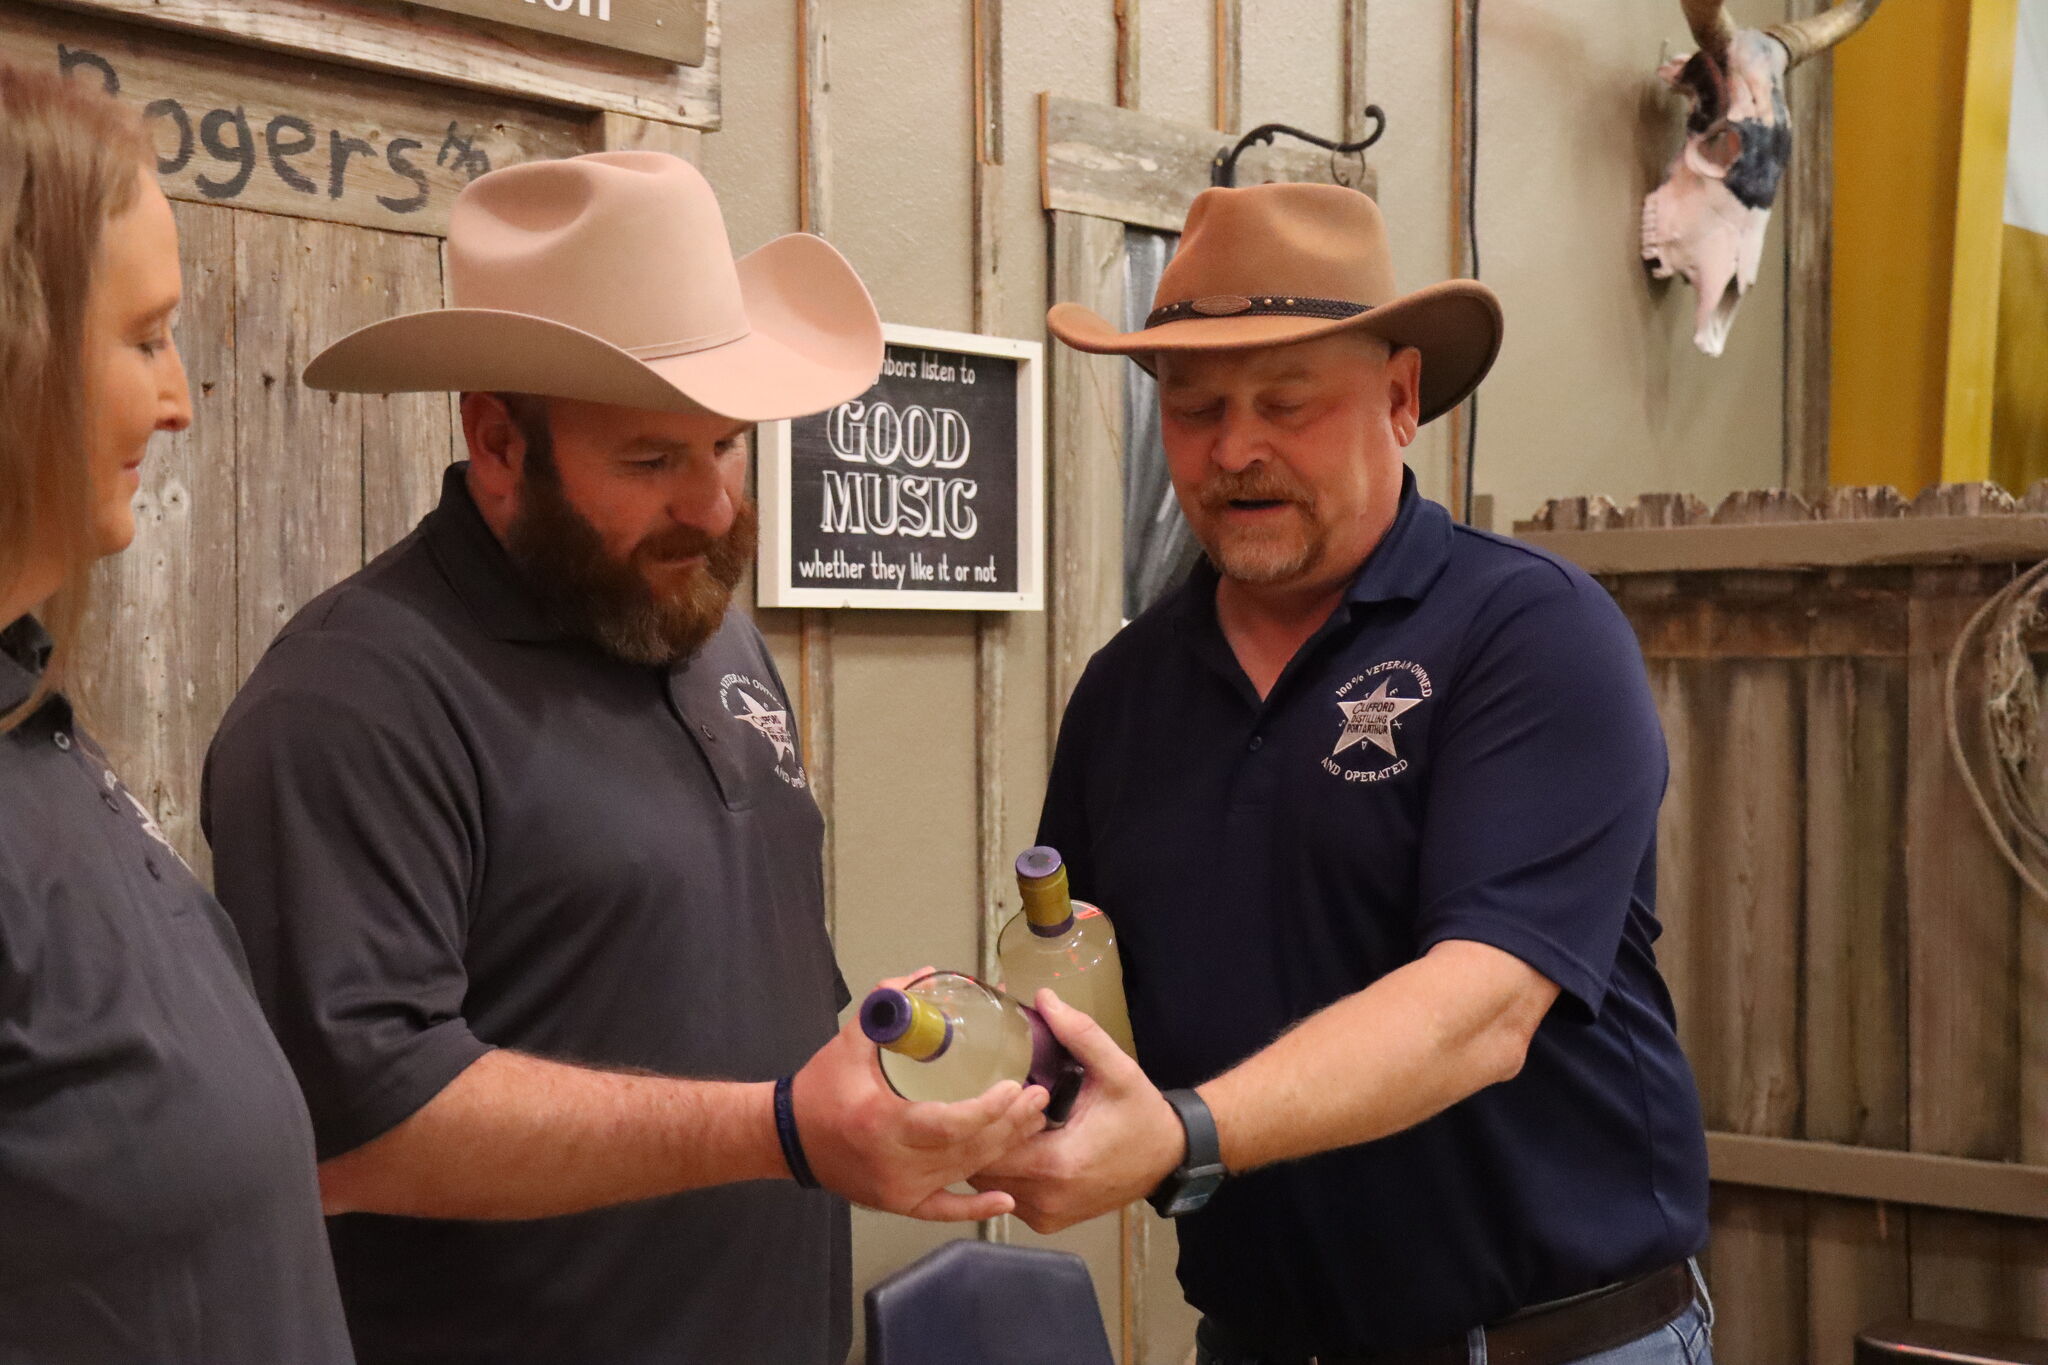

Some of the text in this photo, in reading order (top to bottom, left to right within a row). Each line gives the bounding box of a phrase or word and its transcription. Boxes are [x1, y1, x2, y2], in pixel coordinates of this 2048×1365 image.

[921, 351, 956, 382] listen
[960, 356, 976, 385] to
[826, 399, 971, 469] GOOD
[819, 469, 978, 540] MUSIC
[799, 548, 998, 590] whether they like it or not
[1365, 660, 1412, 676] VETERAN
[1410, 664, 1433, 698] OWNED
[1351, 702, 1395, 715] CLIFFORD
[1320, 756, 1409, 783] AND OPERATED
